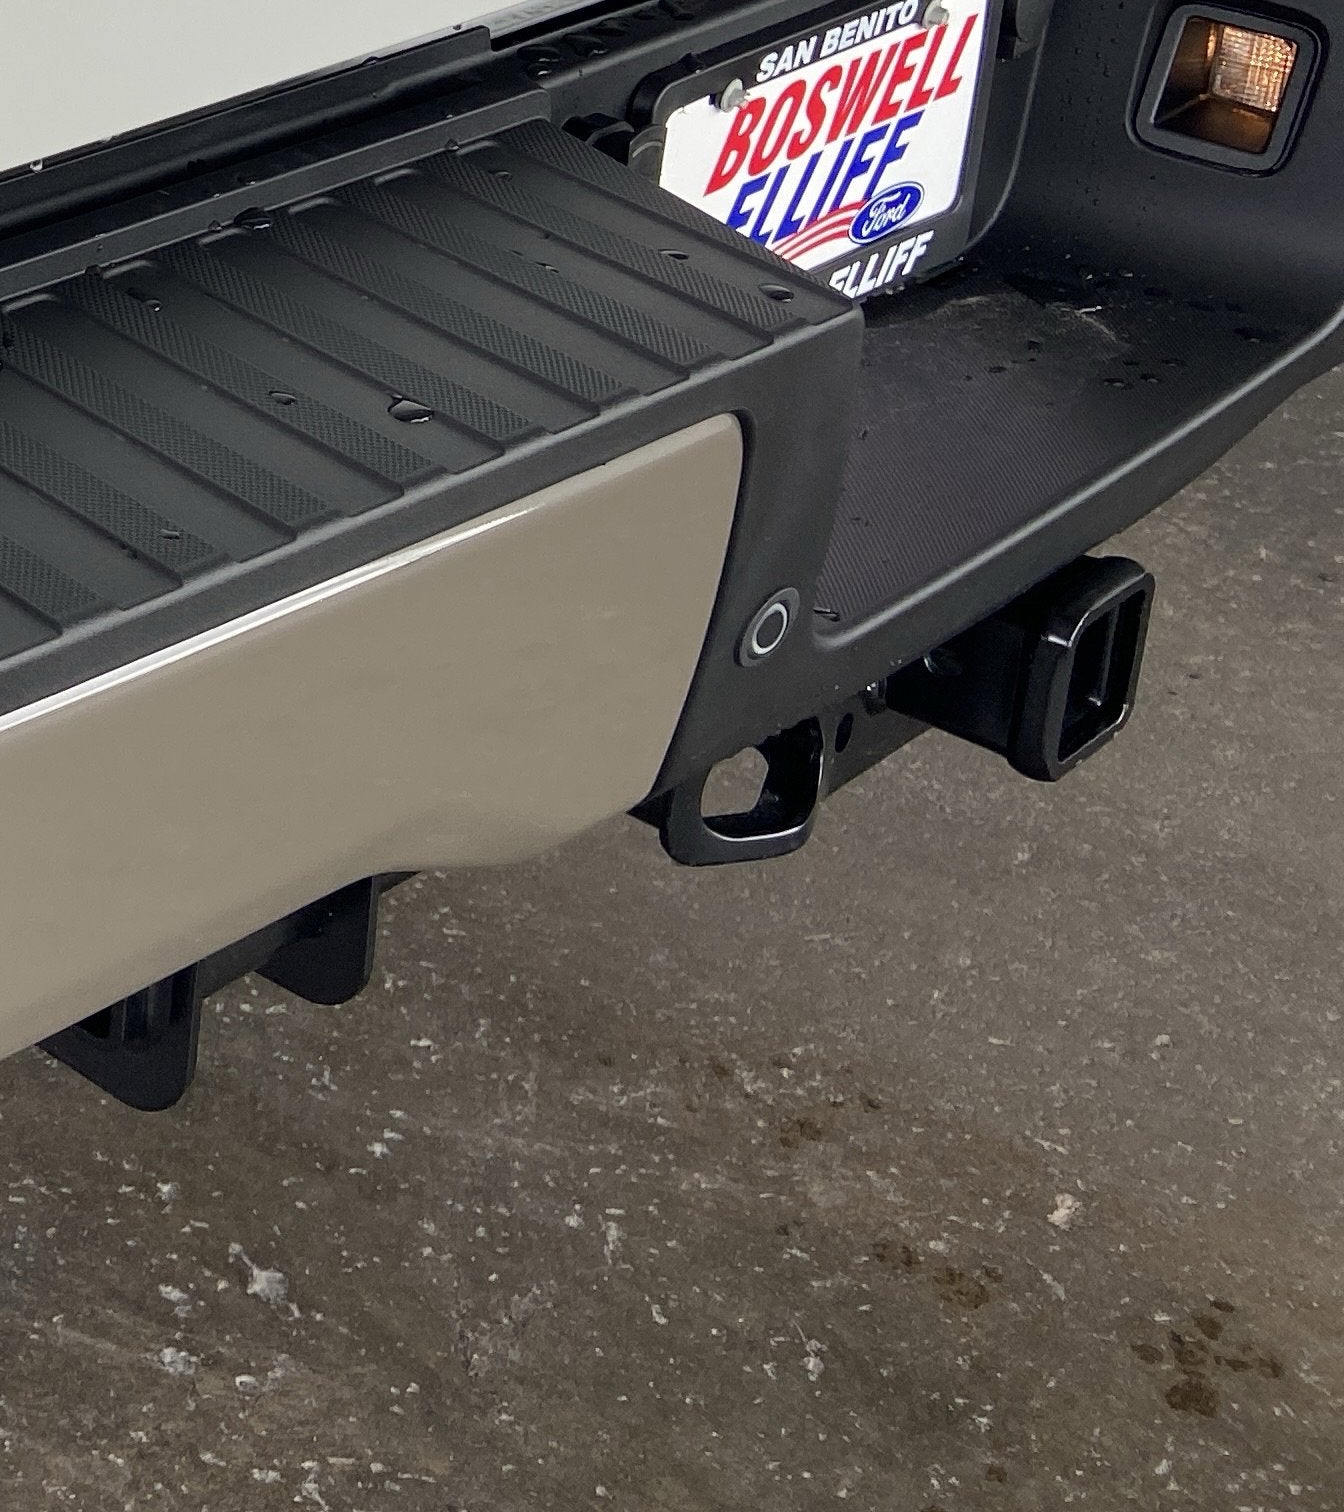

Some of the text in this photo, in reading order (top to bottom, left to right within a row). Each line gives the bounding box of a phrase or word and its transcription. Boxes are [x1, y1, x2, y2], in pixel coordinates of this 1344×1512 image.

[756, 35, 817, 83] SAN
[703, 13, 979, 198] BOSWELL
[726, 109, 925, 245] ELLIFF
[861, 190, 912, 238] Ford
